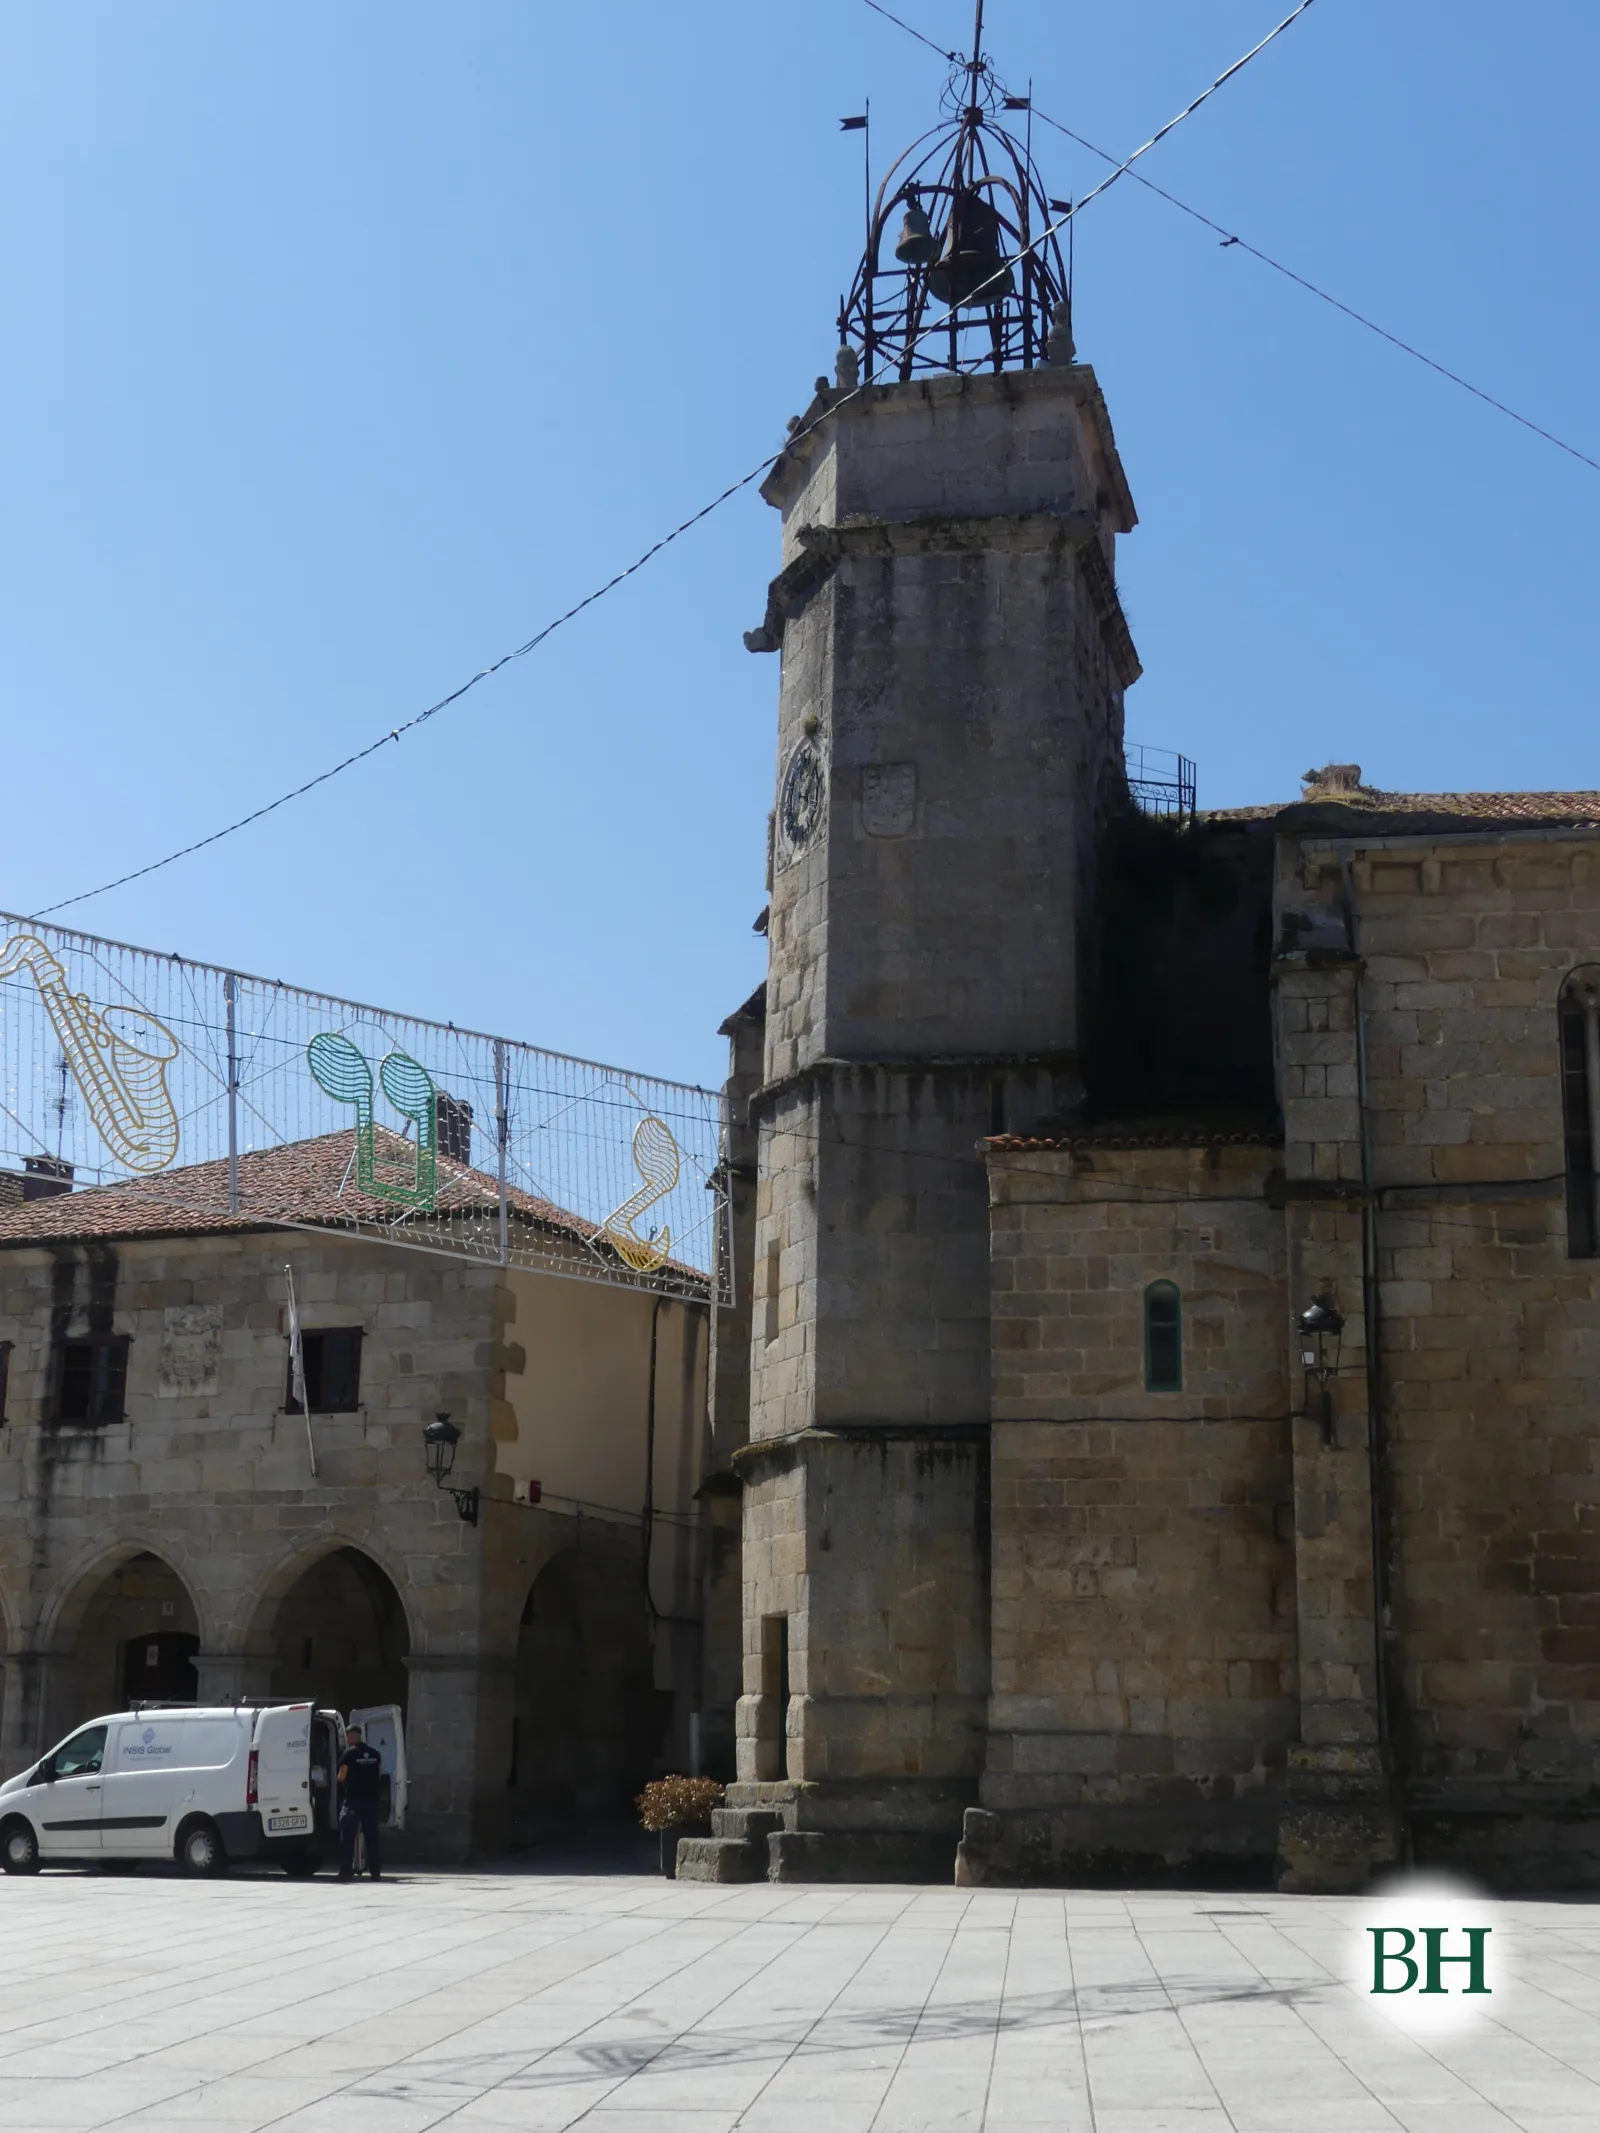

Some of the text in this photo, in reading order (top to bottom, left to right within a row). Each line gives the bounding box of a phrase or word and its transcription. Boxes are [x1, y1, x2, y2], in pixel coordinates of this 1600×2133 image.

[286, 1739, 307, 1749] INSIS
[123, 1745, 172, 1755] INSIS Global
